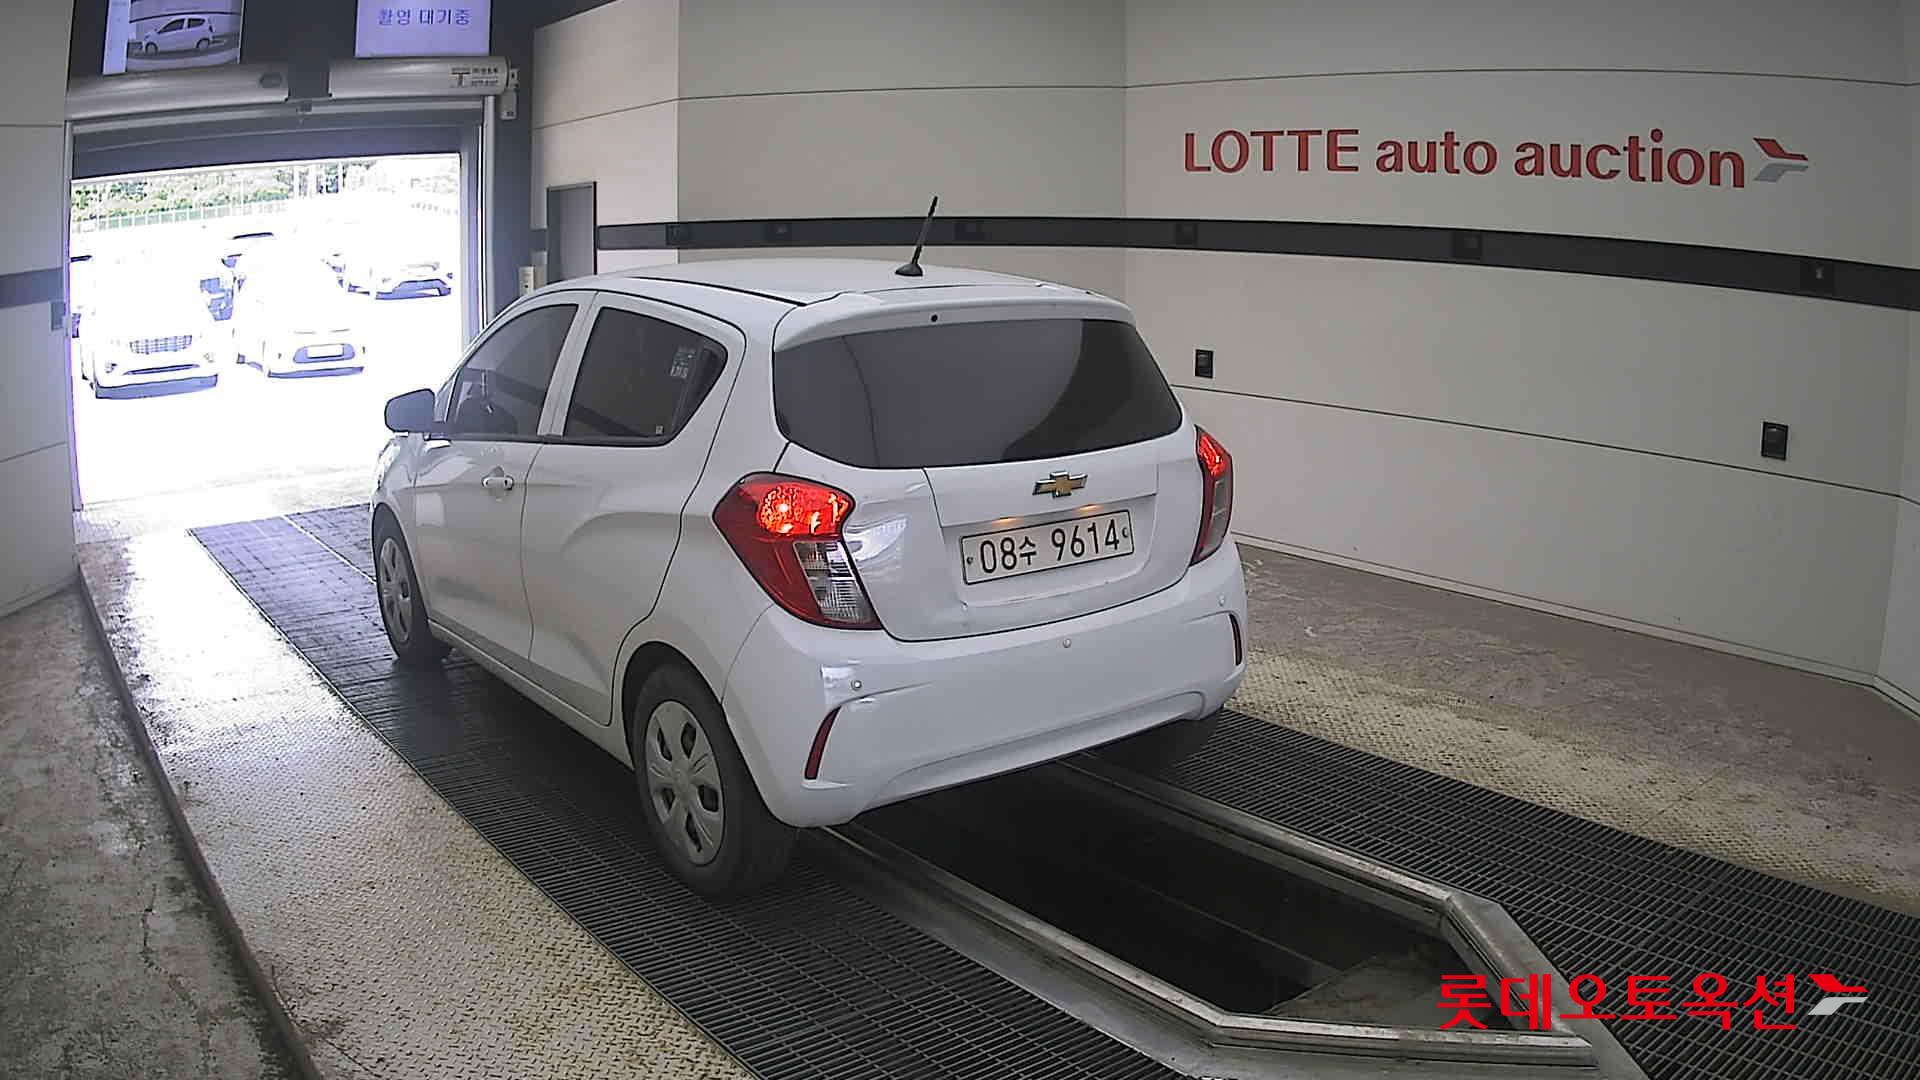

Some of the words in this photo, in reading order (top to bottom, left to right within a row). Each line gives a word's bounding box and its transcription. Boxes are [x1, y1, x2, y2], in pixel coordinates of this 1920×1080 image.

[419, 8, 470, 26] 대기중
[1184, 129, 1359, 173] LOTTE
[1376, 132, 1498, 175] auto
[1515, 129, 1745, 188] auction
[980, 536, 1037, 573] 08수
[1051, 519, 1120, 562] 9614
